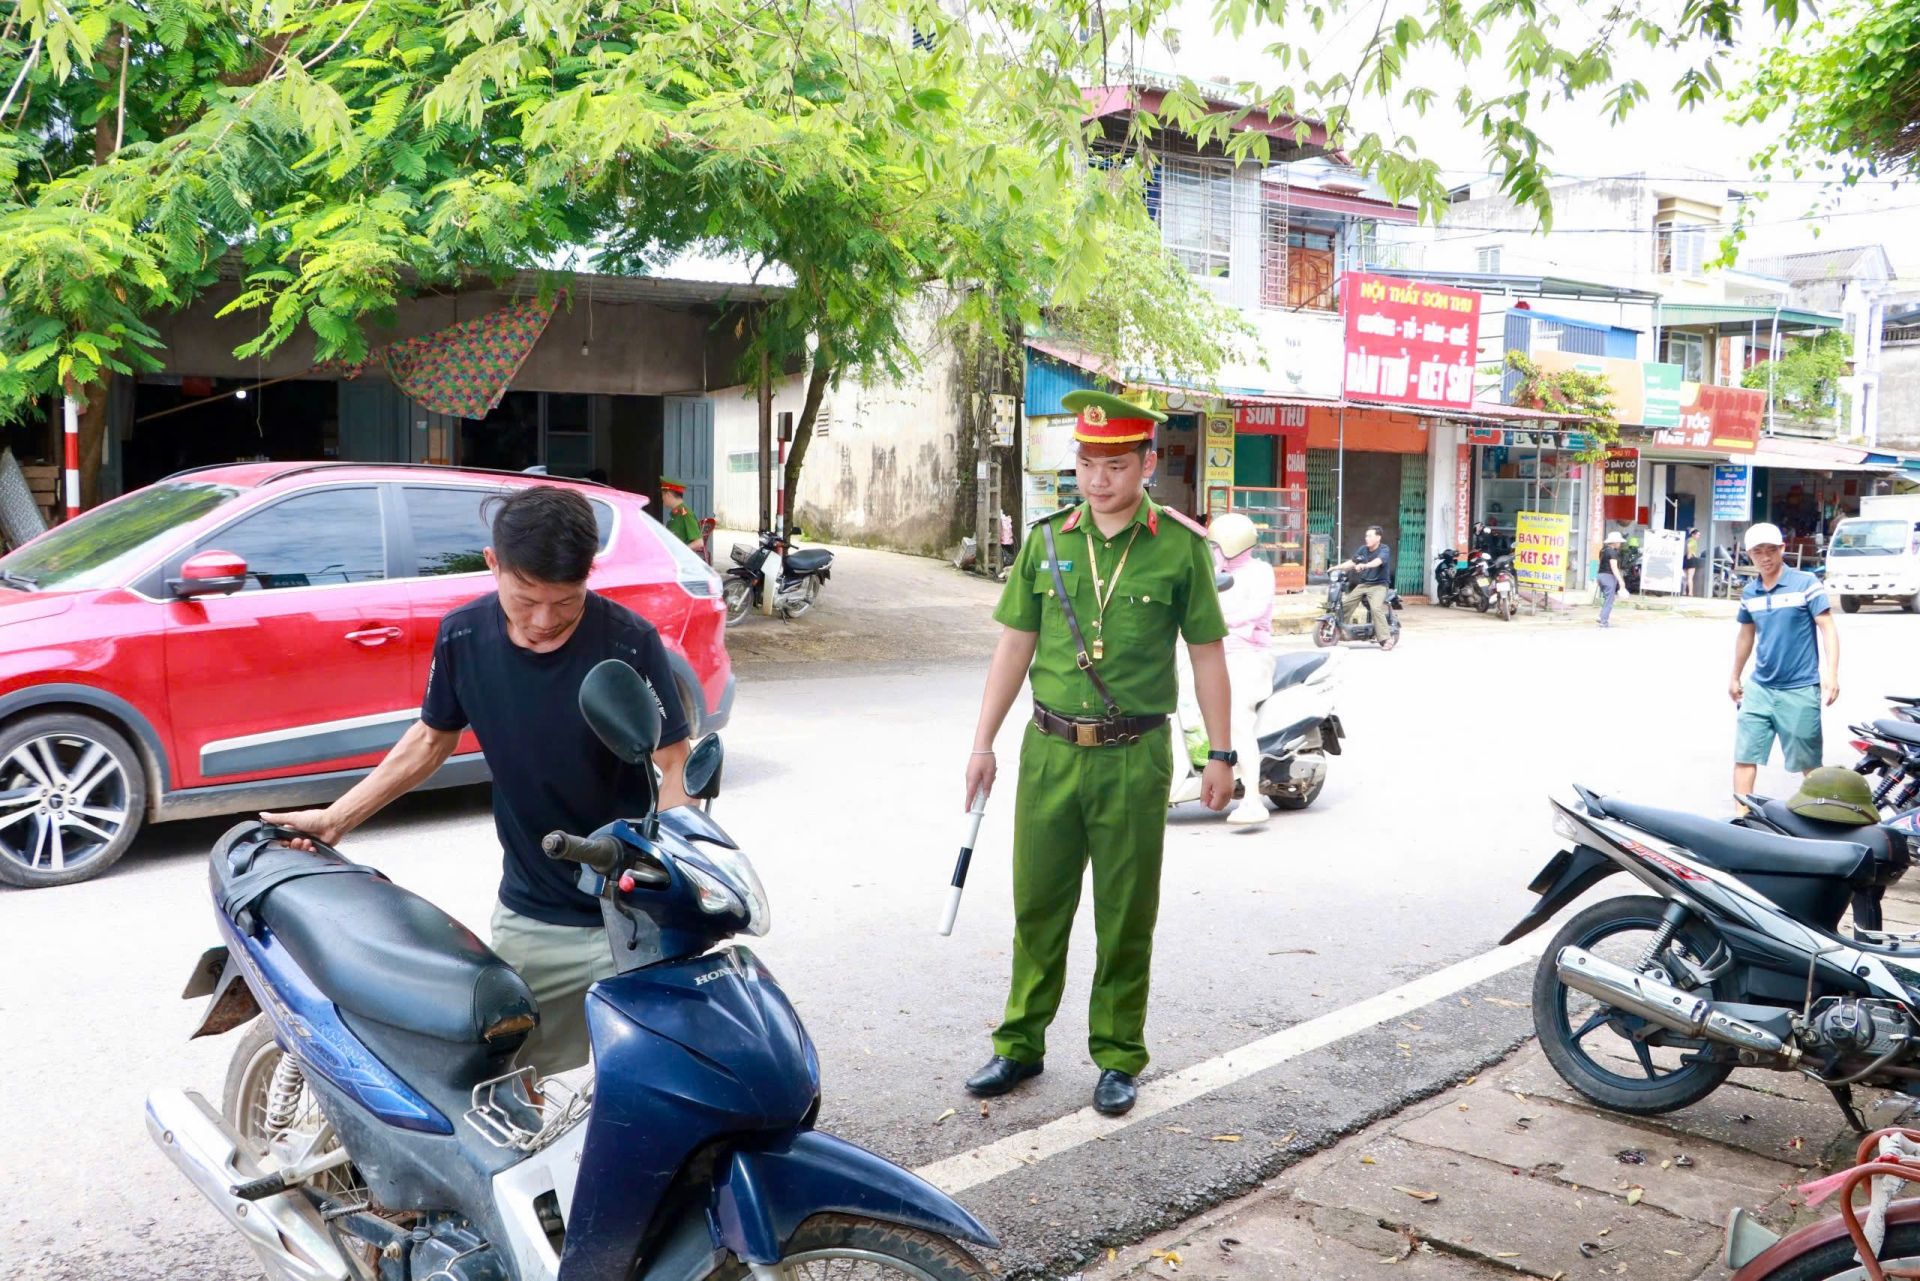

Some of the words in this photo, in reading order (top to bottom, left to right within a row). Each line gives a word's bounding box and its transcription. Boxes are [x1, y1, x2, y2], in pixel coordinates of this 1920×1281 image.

[1360, 280, 1386, 304] NỘI
[1389, 280, 1420, 306] THẤT
[1422, 290, 1448, 309] SƠN
[1449, 296, 1473, 313] THU
